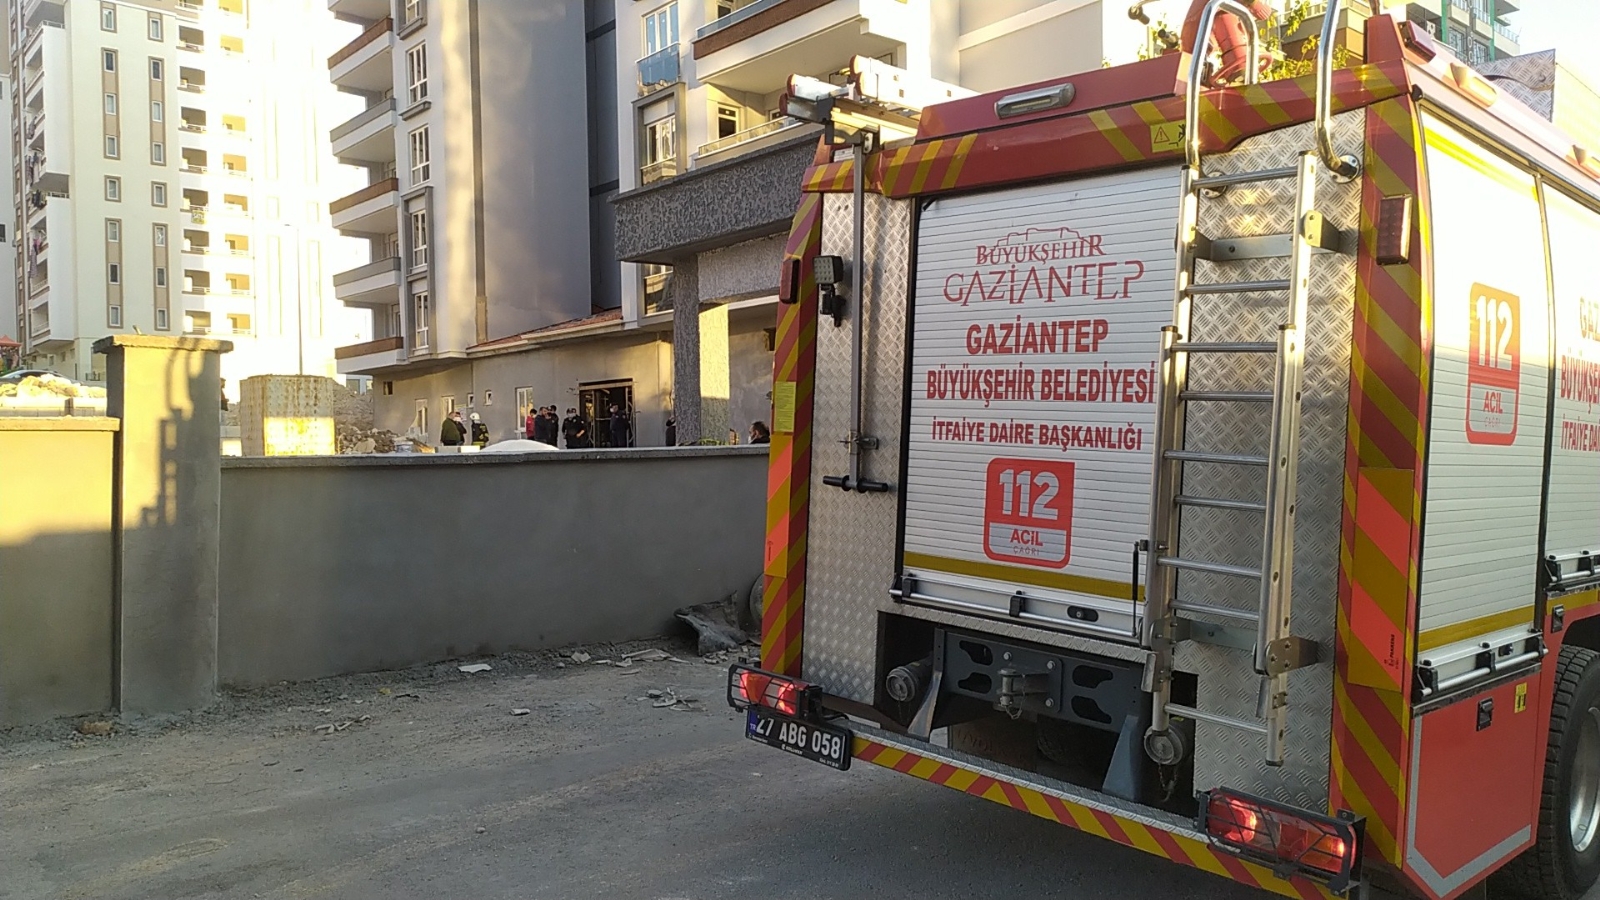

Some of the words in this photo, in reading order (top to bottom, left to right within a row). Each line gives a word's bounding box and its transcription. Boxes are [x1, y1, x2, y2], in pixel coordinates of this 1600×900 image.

[943, 260, 1145, 307] GAZİANTEP
[966, 314, 1109, 355] GAZİANTEP
[1476, 294, 1513, 371] 112
[926, 362, 1035, 407] BÜYÜKŞEHİR
[1040, 361, 1156, 403] BELEDİYESİ
[931, 416, 985, 442] İTFAİYE
[989, 418, 1035, 444] DAİRE
[1039, 422, 1142, 452] BAŞKANLIĞI
[1560, 413, 1588, 451] İTFAİYE
[999, 468, 1060, 521] 112
[749, 722, 757, 730] TR
[778, 722, 807, 748] ABG
[811, 730, 841, 759] 058
